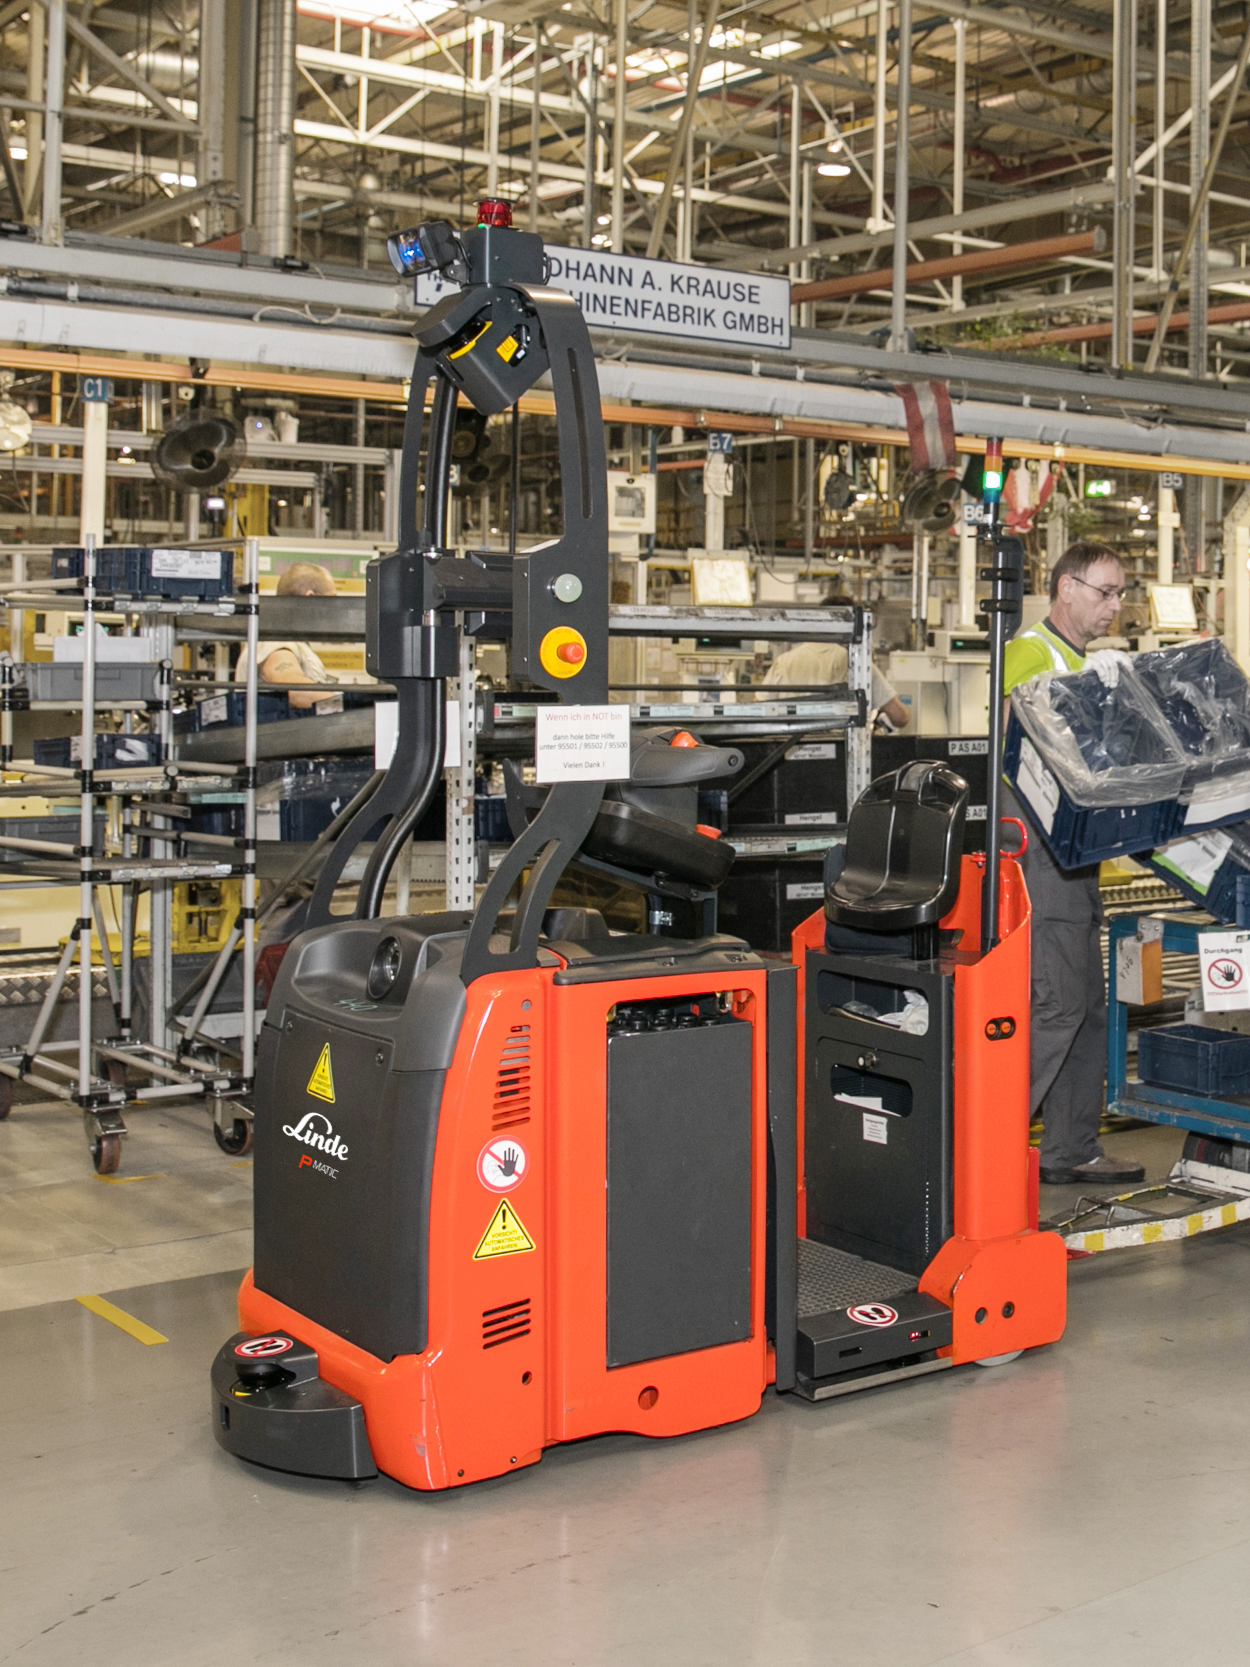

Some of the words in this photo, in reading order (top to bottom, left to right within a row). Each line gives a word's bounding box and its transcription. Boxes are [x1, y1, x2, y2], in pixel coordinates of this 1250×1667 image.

[549, 257, 633, 287] OHANN
[641, 270, 662, 291] A.
[670, 274, 761, 304] KRAUSE
[569, 290, 716, 328] HINENFABRIK
[723, 311, 784, 336] GMBH
[83, 377, 103, 398] C1
[709, 433, 732, 450] B7
[1161, 472, 1183, 487] B5
[963, 504, 985, 521] B6
[545, 713, 569, 721] Wenn
[570, 713, 581, 721] ich
[592, 712, 609, 720] NOT
[610, 712, 622, 720] bin
[552, 733, 569, 741] dann
[585, 732, 600, 740] bitte
[601, 732, 615, 740] Hilfe
[539, 743, 556, 751] unter
[557, 742, 578, 750] 95501
[583, 742, 603, 750] 95502
[608, 741, 628, 749] 95500
[951, 743, 957, 753] P
[958, 742, 970, 752] AS
[971, 742, 986, 752] A01
[799, 814, 823, 822] Hengst
[972, 808, 987, 817] A01
[282, 1112, 349, 1161] Linde
[298, 1153, 313, 1169] P
[312, 1159, 340, 1180] MATIC
